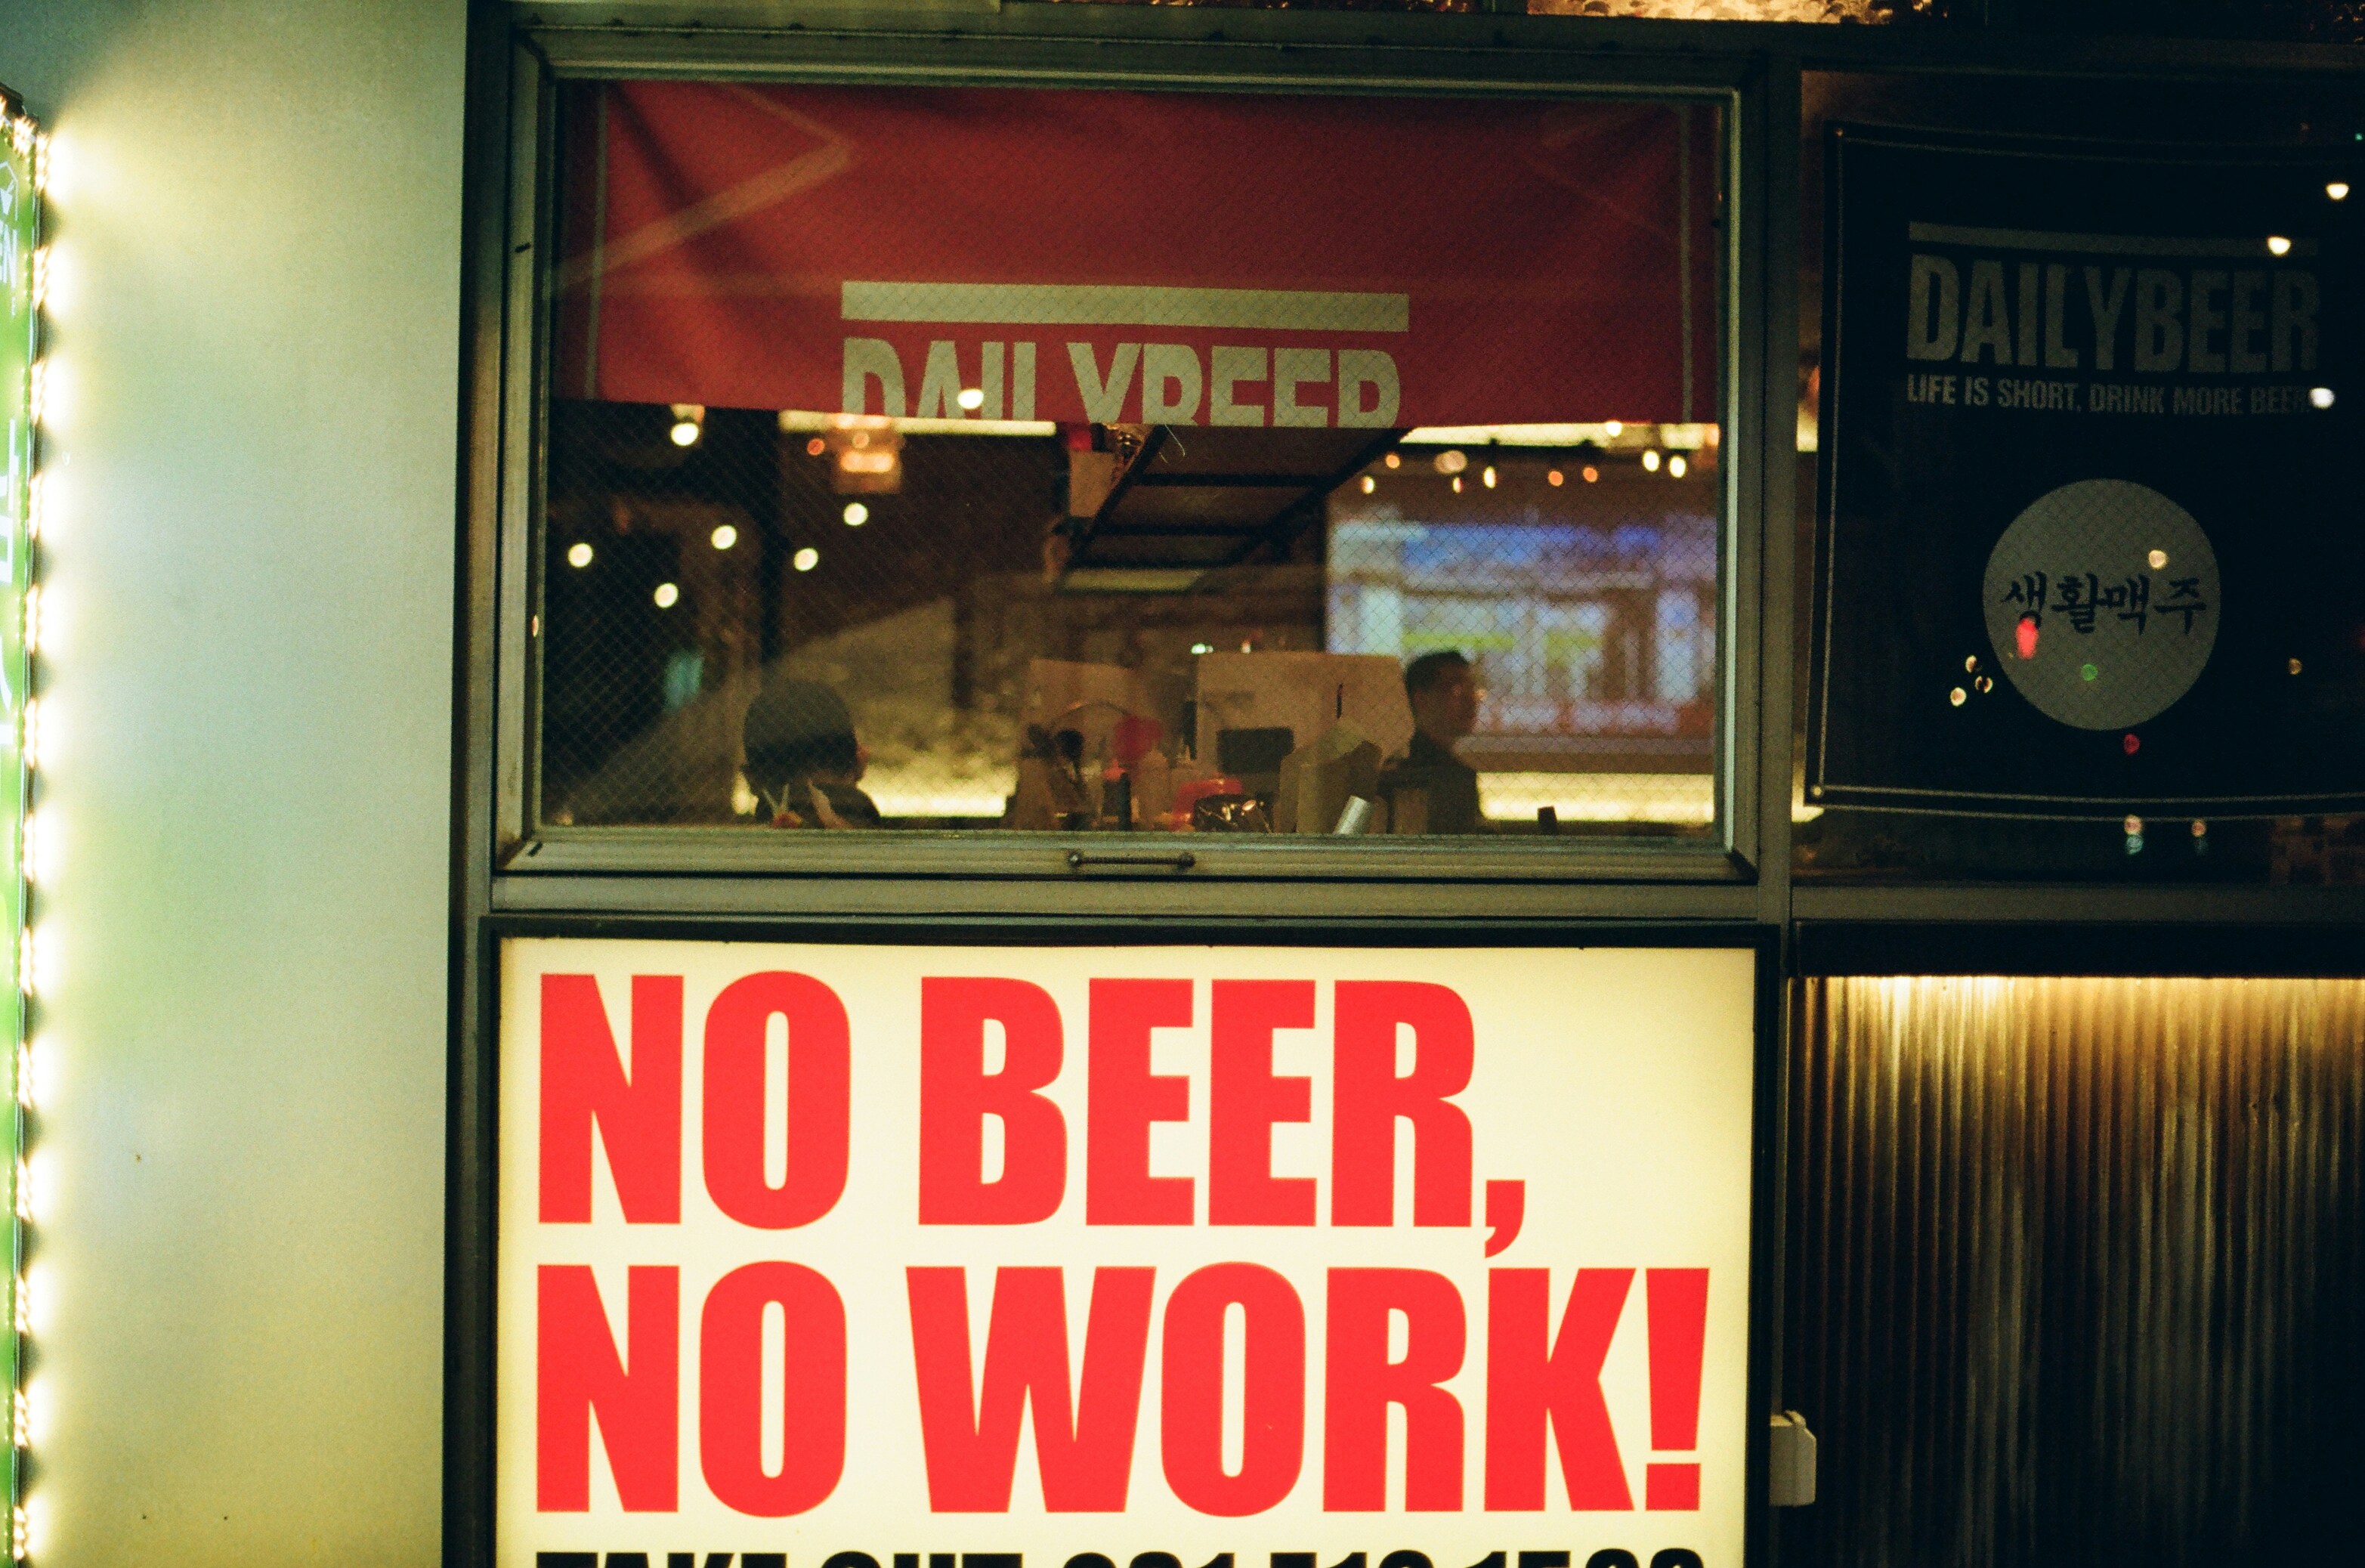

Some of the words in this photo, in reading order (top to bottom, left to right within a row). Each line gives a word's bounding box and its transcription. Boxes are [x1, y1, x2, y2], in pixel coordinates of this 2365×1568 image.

[1906, 253, 2320, 373] DAILYBEER
[1907, 373, 1956, 405] LIFE
[1965, 376, 1989, 407] IS
[2088, 382, 2166, 414] DRINK
[2172, 386, 2243, 415] MORE
[2002, 571, 2207, 636] 생활맥주
[539, 970, 852, 1230] NO
[918, 976, 1526, 1259] BEER,
[536, 1260, 846, 1518] NO
[906, 1262, 1710, 1518] WORK!
